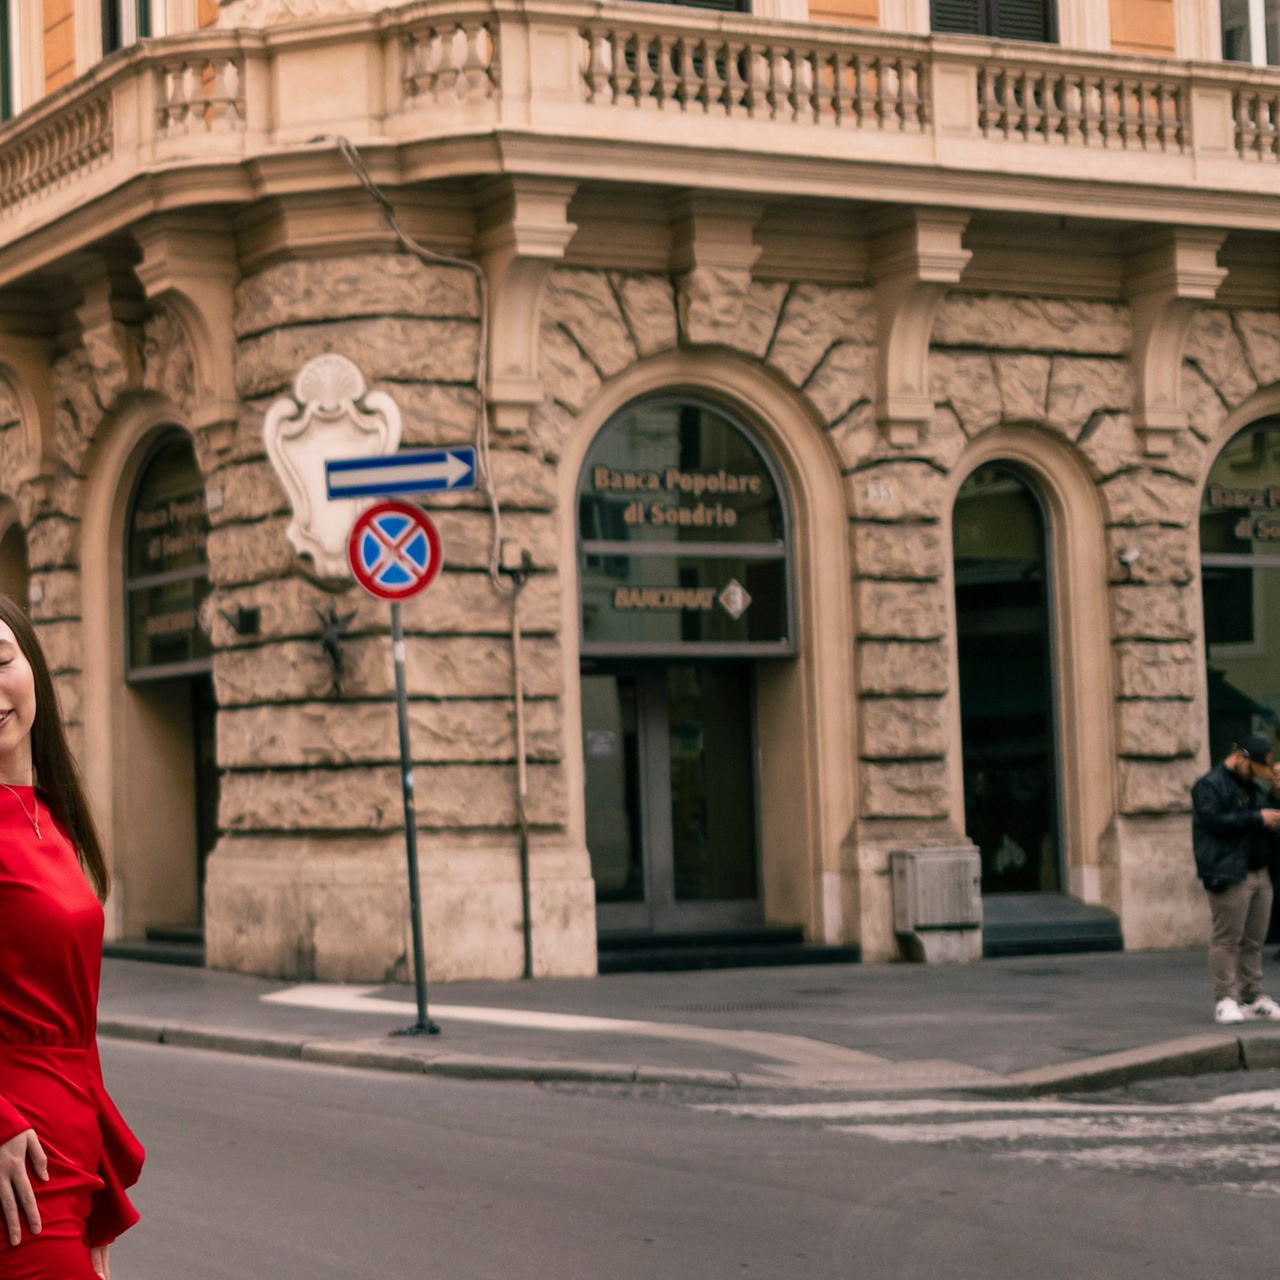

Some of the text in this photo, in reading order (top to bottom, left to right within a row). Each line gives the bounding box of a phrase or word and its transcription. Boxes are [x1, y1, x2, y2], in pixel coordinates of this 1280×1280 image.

[594, 467, 762, 496] Banca Popolare
[623, 501, 737, 527] di Sondrio
